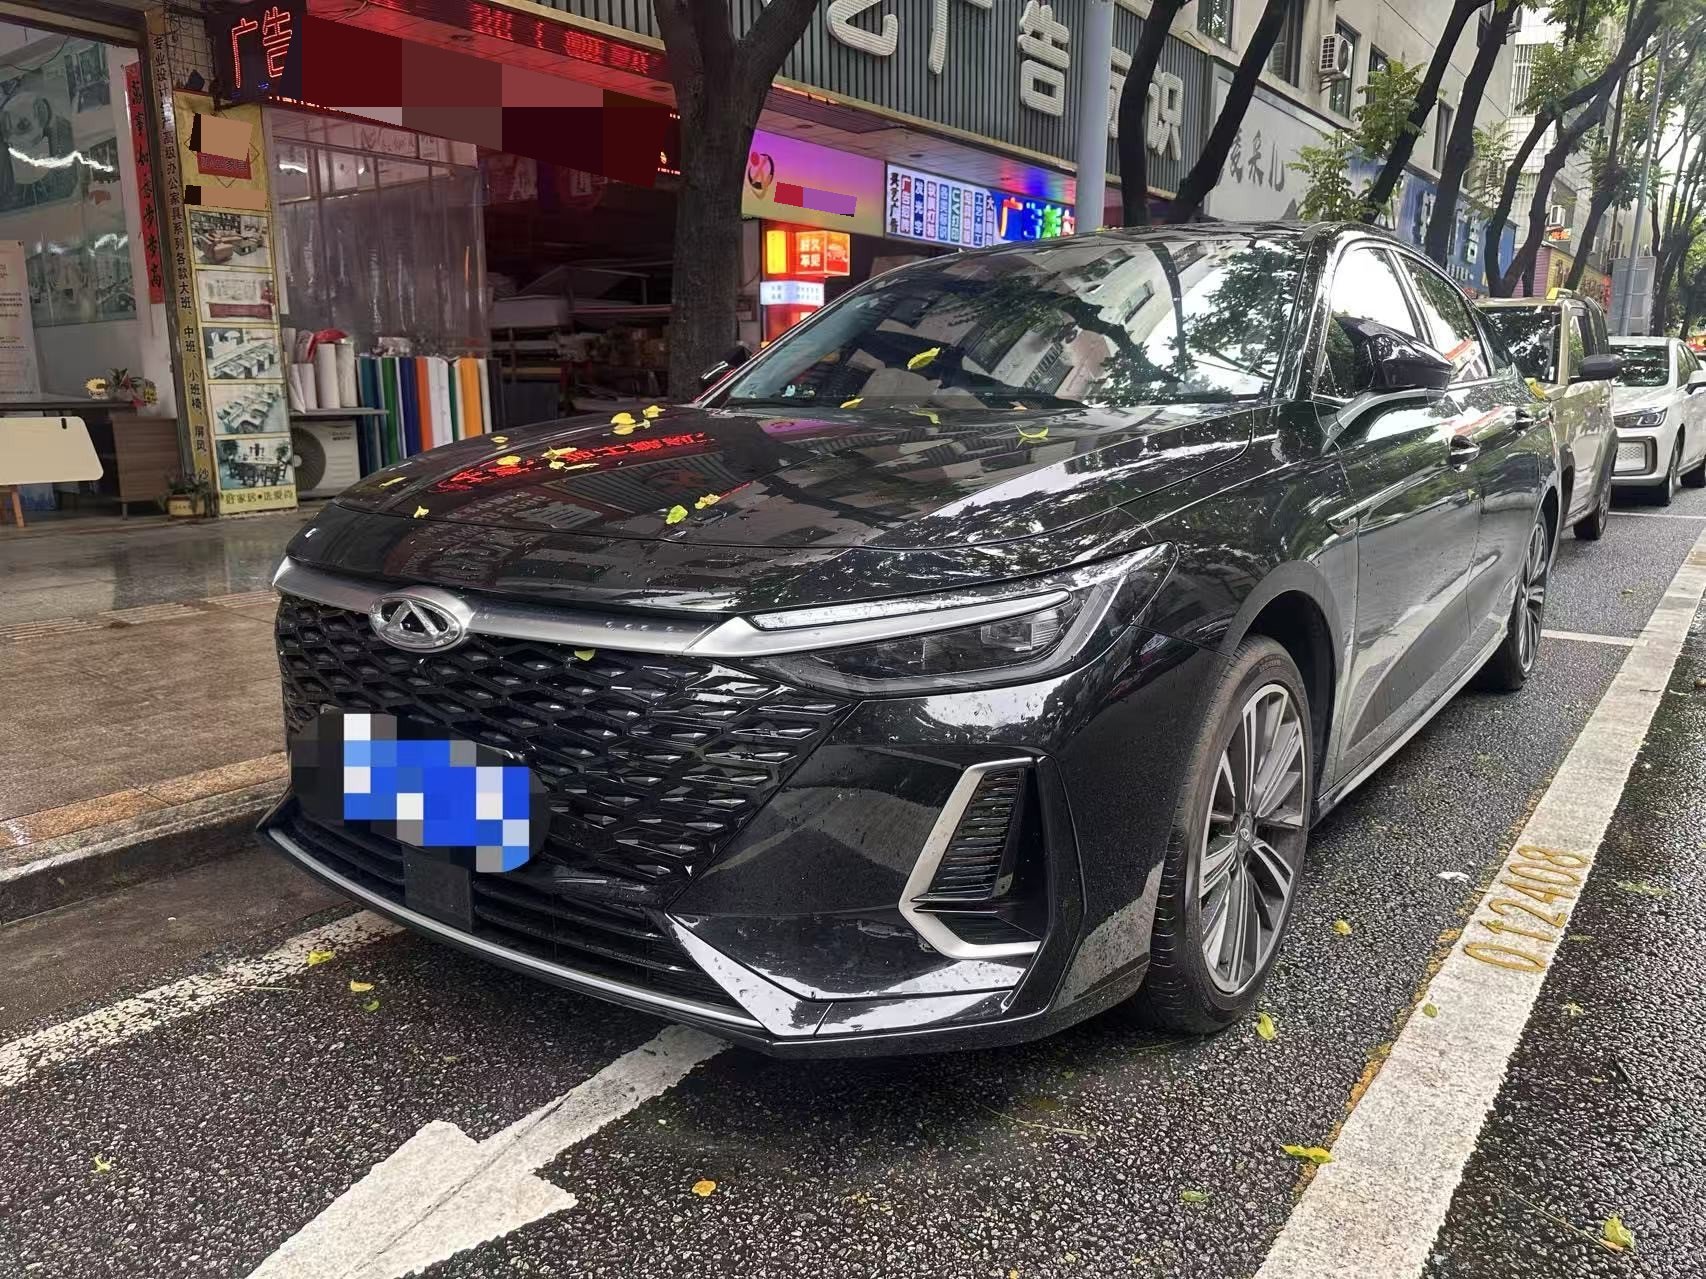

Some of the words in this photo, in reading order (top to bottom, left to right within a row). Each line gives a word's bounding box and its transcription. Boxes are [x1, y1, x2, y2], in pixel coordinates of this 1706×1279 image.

[231, 6, 293, 89] 广告
[914, 178, 924, 236] 发光字
[1464, 845, 1590, 973] 012408
